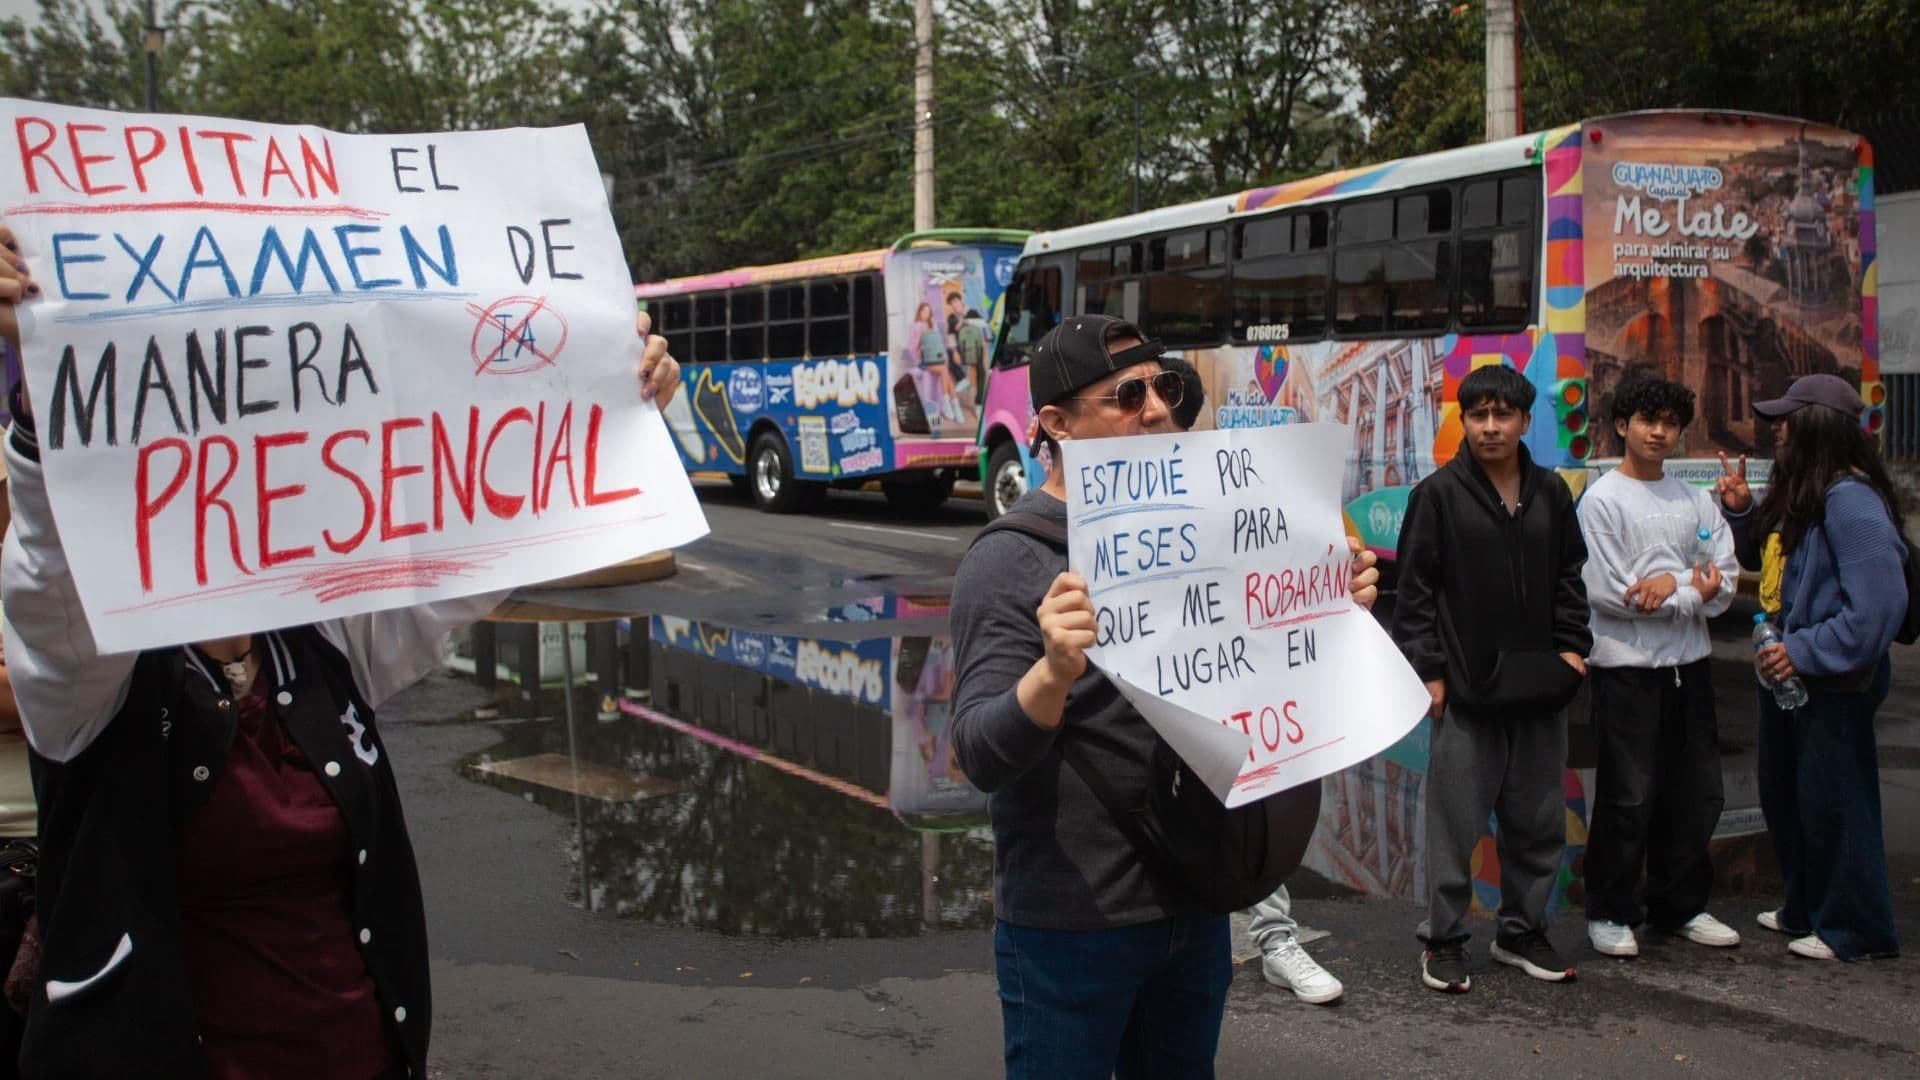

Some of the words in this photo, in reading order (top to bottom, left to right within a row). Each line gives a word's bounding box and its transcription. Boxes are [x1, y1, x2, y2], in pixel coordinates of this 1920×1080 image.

[15, 116, 340, 199] REPITAN
[391, 144, 459, 192] EL
[1613, 163, 1722, 189] GUANAJUATO
[1614, 194, 1671, 237] Me
[1677, 197, 1759, 240] late
[1648, 184, 1689, 199] Capital
[53, 224, 460, 303] EXAMEN
[506, 218, 583, 283] DE
[1613, 242, 1649, 260] para
[1652, 241, 1710, 259] admirar
[1712, 246, 1730, 259] su
[1614, 258, 1708, 281] arquitectura
[493, 313, 536, 362] IA
[1246, 323, 1289, 341] 0760125
[49, 321, 380, 449] MANERA
[792, 359, 881, 409] ESCOLAR
[135, 402, 642, 593] PRESENCIAL
[1081, 442, 1188, 505] ESTUDIÉ
[1217, 447, 1265, 496] POR
[1094, 523, 1198, 582] MESES
[1233, 507, 1289, 554] PARA
[1095, 600, 1156, 649] QUE
[1182, 581, 1225, 628] ME
[1245, 543, 1350, 625] ROBARÁN
[1155, 635, 1256, 697] LUGAR
[1288, 628, 1317, 670] EN
[1221, 700, 1305, 763] TOS
